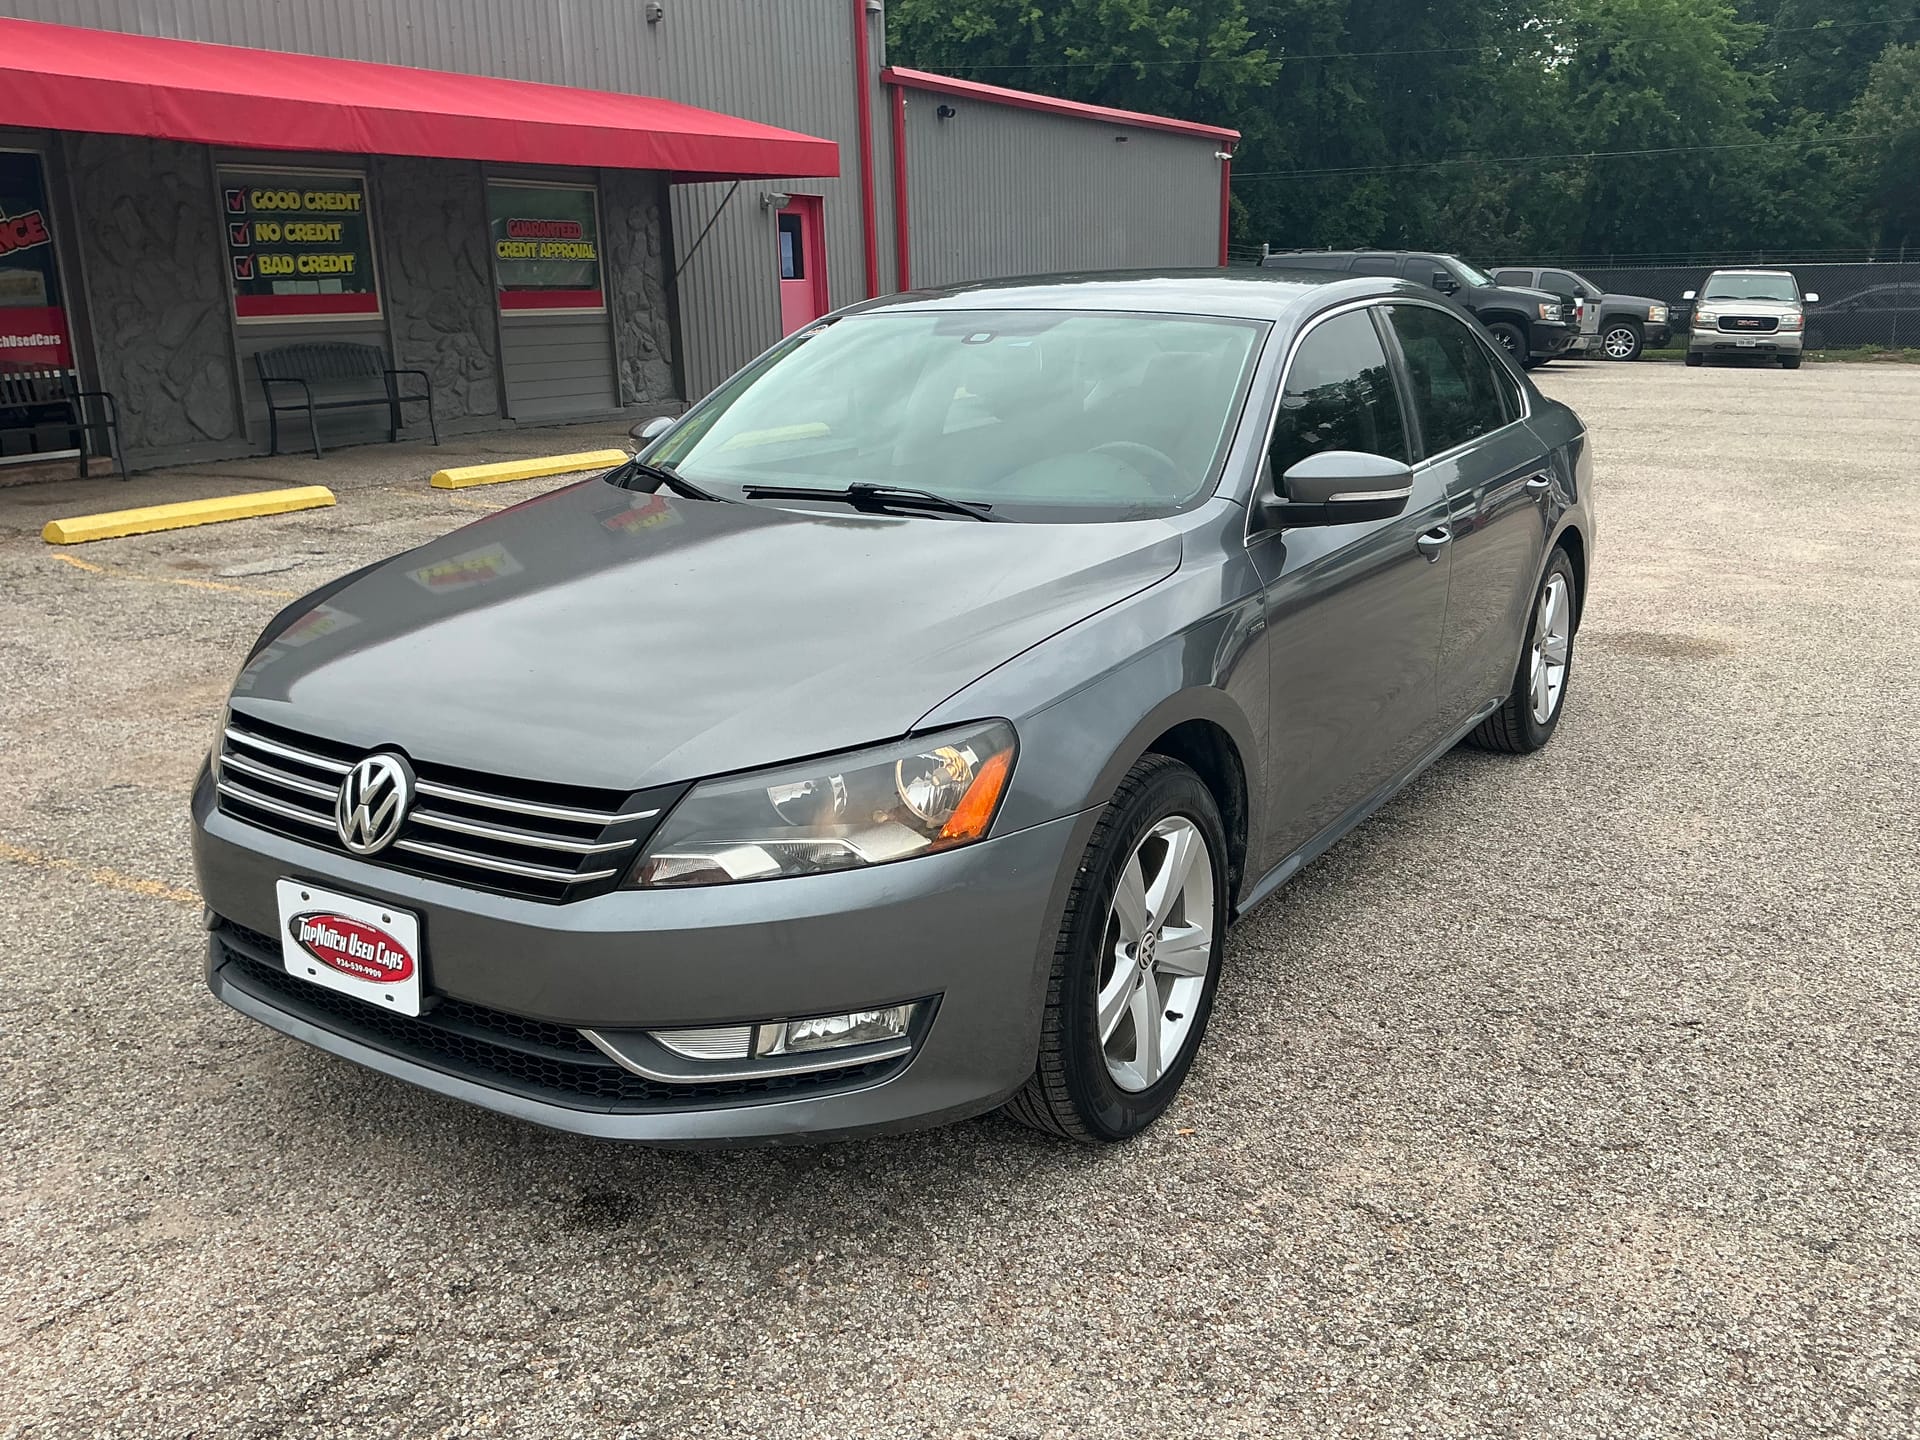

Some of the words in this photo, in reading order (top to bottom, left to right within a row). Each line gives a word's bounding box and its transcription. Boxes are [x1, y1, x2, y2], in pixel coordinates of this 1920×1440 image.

[251, 191, 301, 210] GOOD
[304, 192, 360, 211] CREDIT
[255, 223, 282, 241] NO
[284, 223, 341, 241] CREDIT
[509, 220, 581, 239] GUARANTEED
[497, 241, 537, 258] CREDIT
[540, 242, 596, 259] APPROVAL
[259, 256, 295, 274] BAD
[297, 255, 354, 273] CREDIT
[335, 957, 382, 979] 936-539-9909
